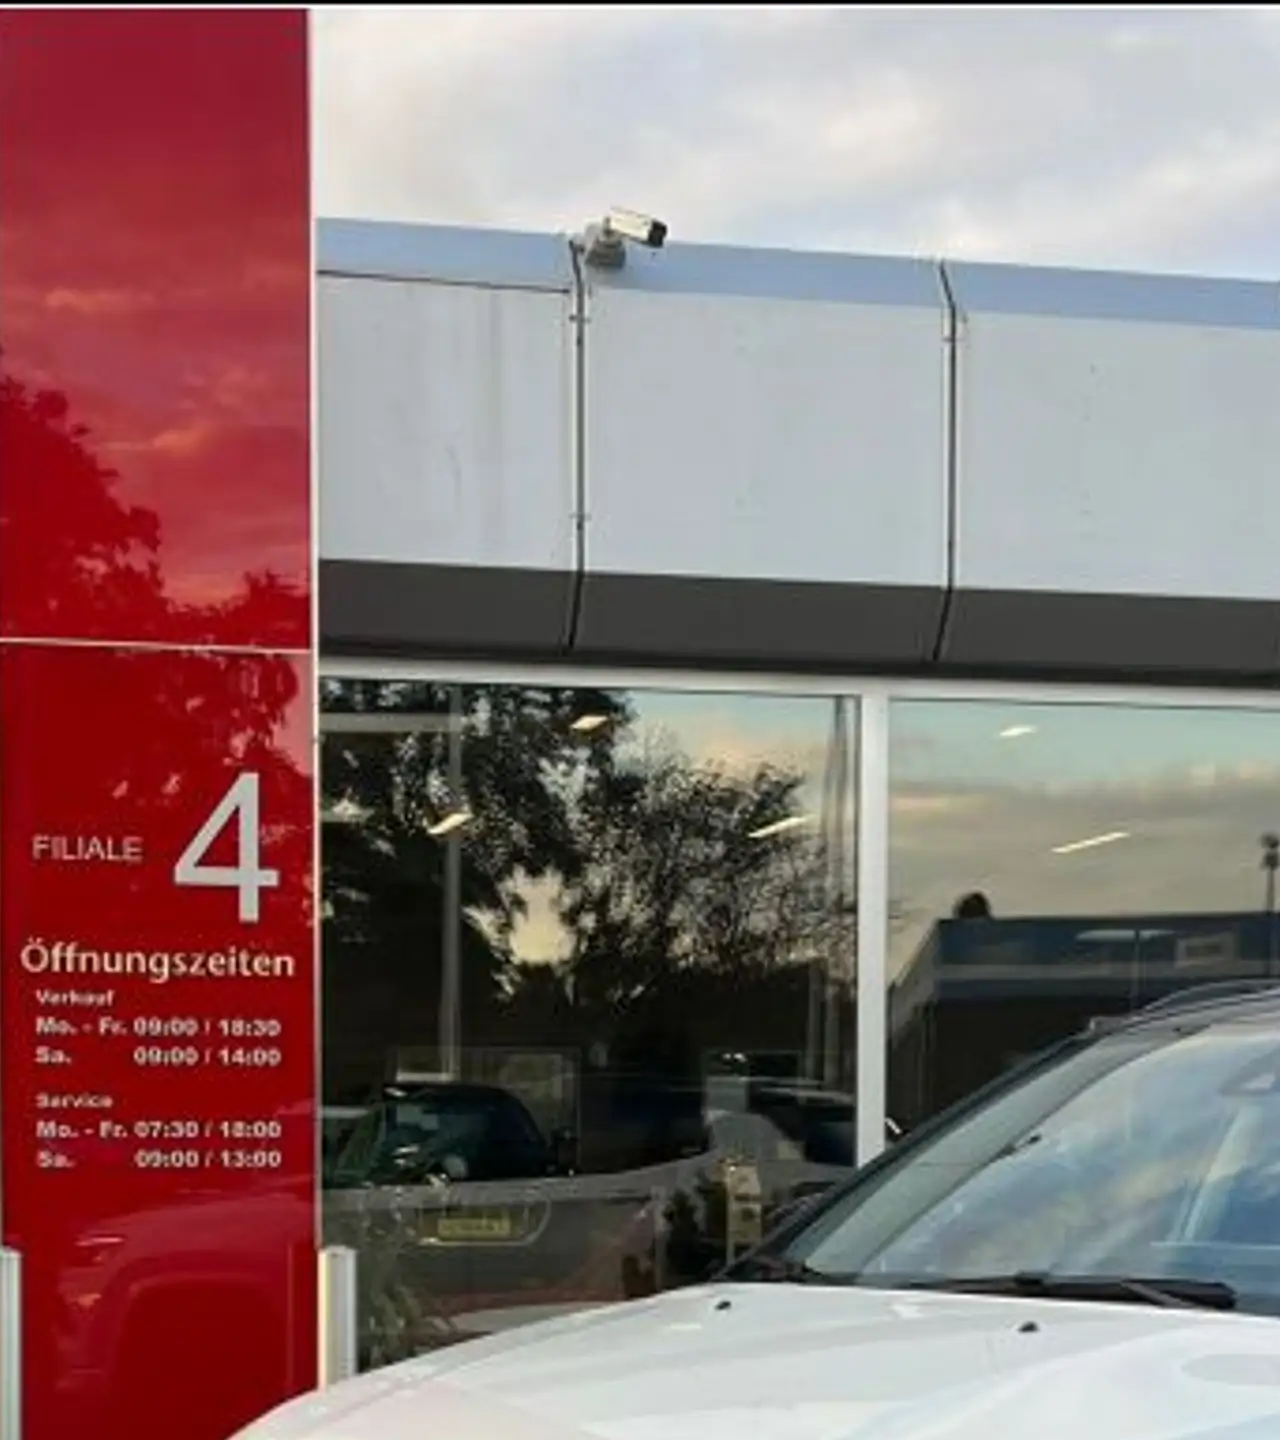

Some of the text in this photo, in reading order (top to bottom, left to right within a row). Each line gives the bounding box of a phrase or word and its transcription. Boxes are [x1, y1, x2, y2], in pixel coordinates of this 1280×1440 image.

[32, 771, 280, 923] FILIALE 4
[20, 937, 296, 983] Öffnungszeiten
[36, 989, 114, 1006] Verkauf
[36, 1016, 77, 1035] Mo.
[99, 1016, 127, 1035] Fr.
[133, 1017, 198, 1036] 09:00
[220, 1019, 281, 1037] 18:30
[35, 1047, 71, 1064] Sa.
[133, 1047, 198, 1065] 09:00
[220, 1048, 281, 1066] 14:00
[36, 1092, 113, 1109] Service
[36, 1121, 78, 1138] Mo.
[99, 1121, 127, 1138] Fr.
[133, 1121, 198, 1138] 07:30
[221, 1121, 282, 1138] 18:00
[38, 1151, 73, 1167] Sa.
[134, 1150, 199, 1168] 09:00
[221, 1150, 282, 1168] 13:00
